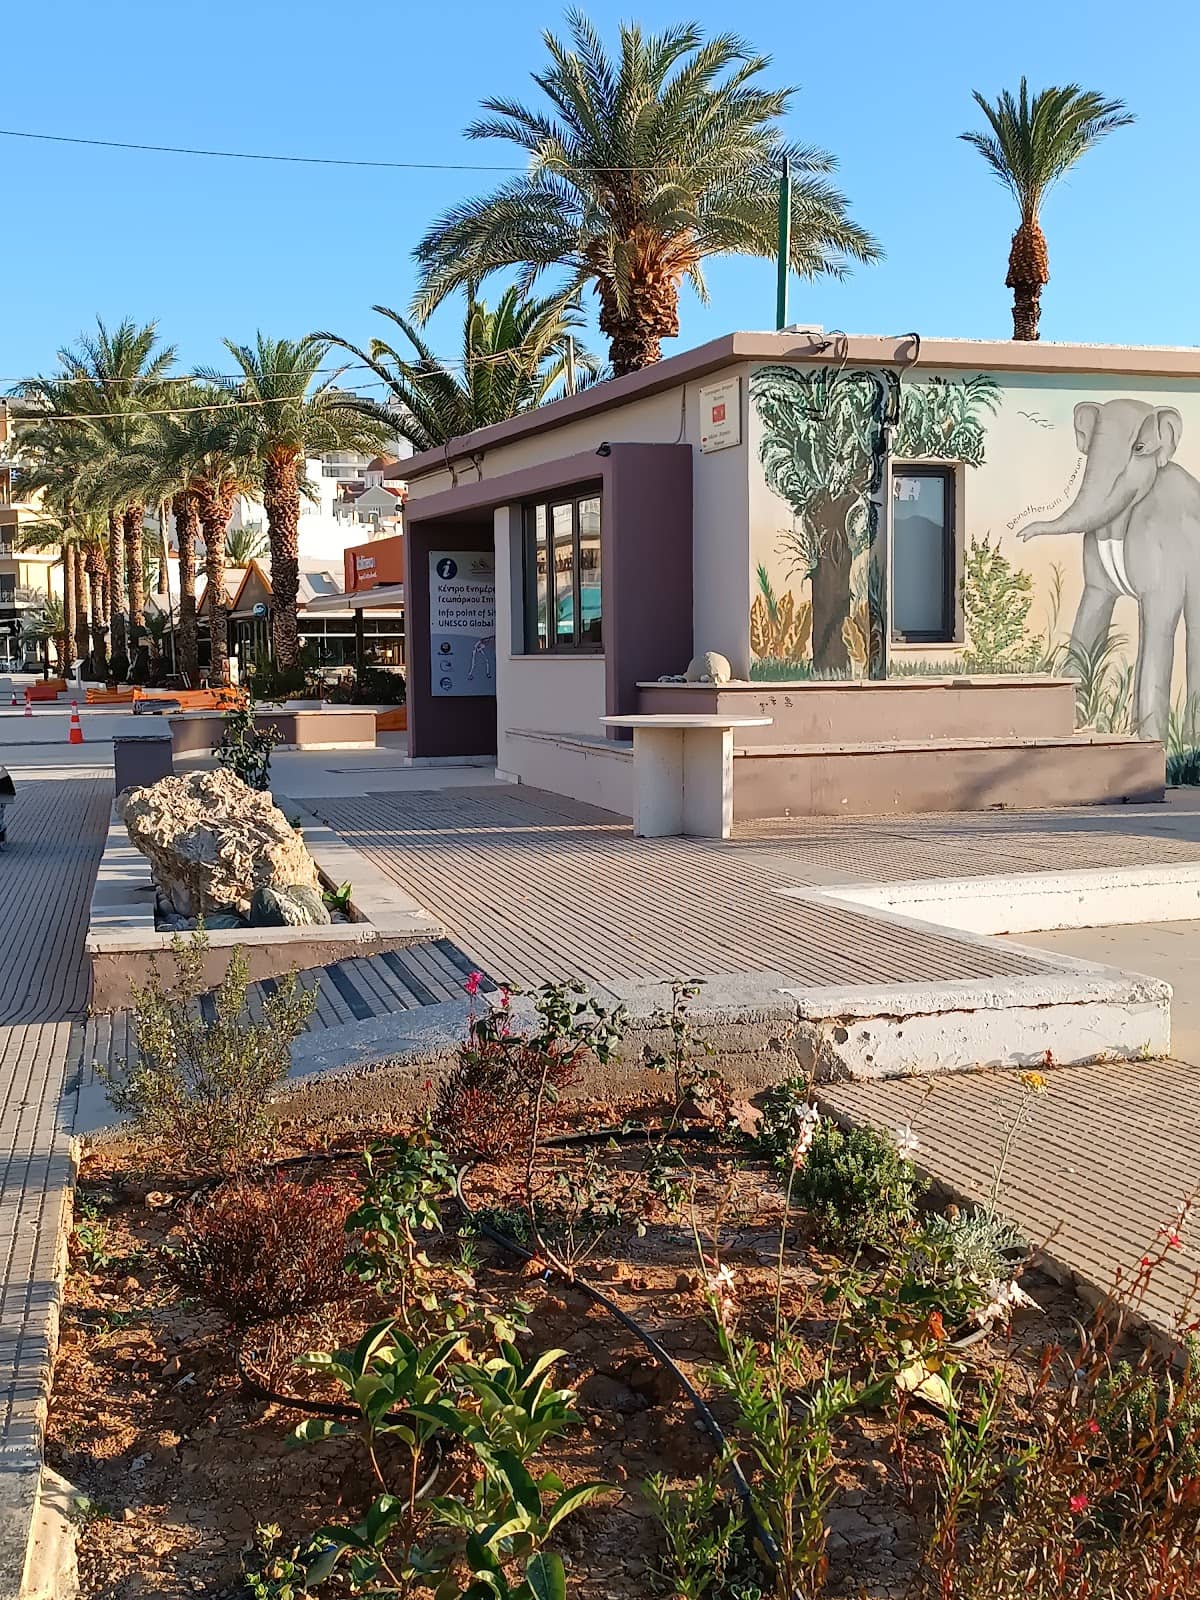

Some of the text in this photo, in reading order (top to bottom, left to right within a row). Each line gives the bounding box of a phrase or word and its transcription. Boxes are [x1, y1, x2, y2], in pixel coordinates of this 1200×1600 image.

[438, 584, 465, 594] Κέντρο
[438, 594, 480, 605] Γεωπάρκου
[438, 609, 454, 618] Info
[455, 609, 476, 618] point
[477, 609, 485, 618] of
[438, 619, 494, 628] UNESCO Global
